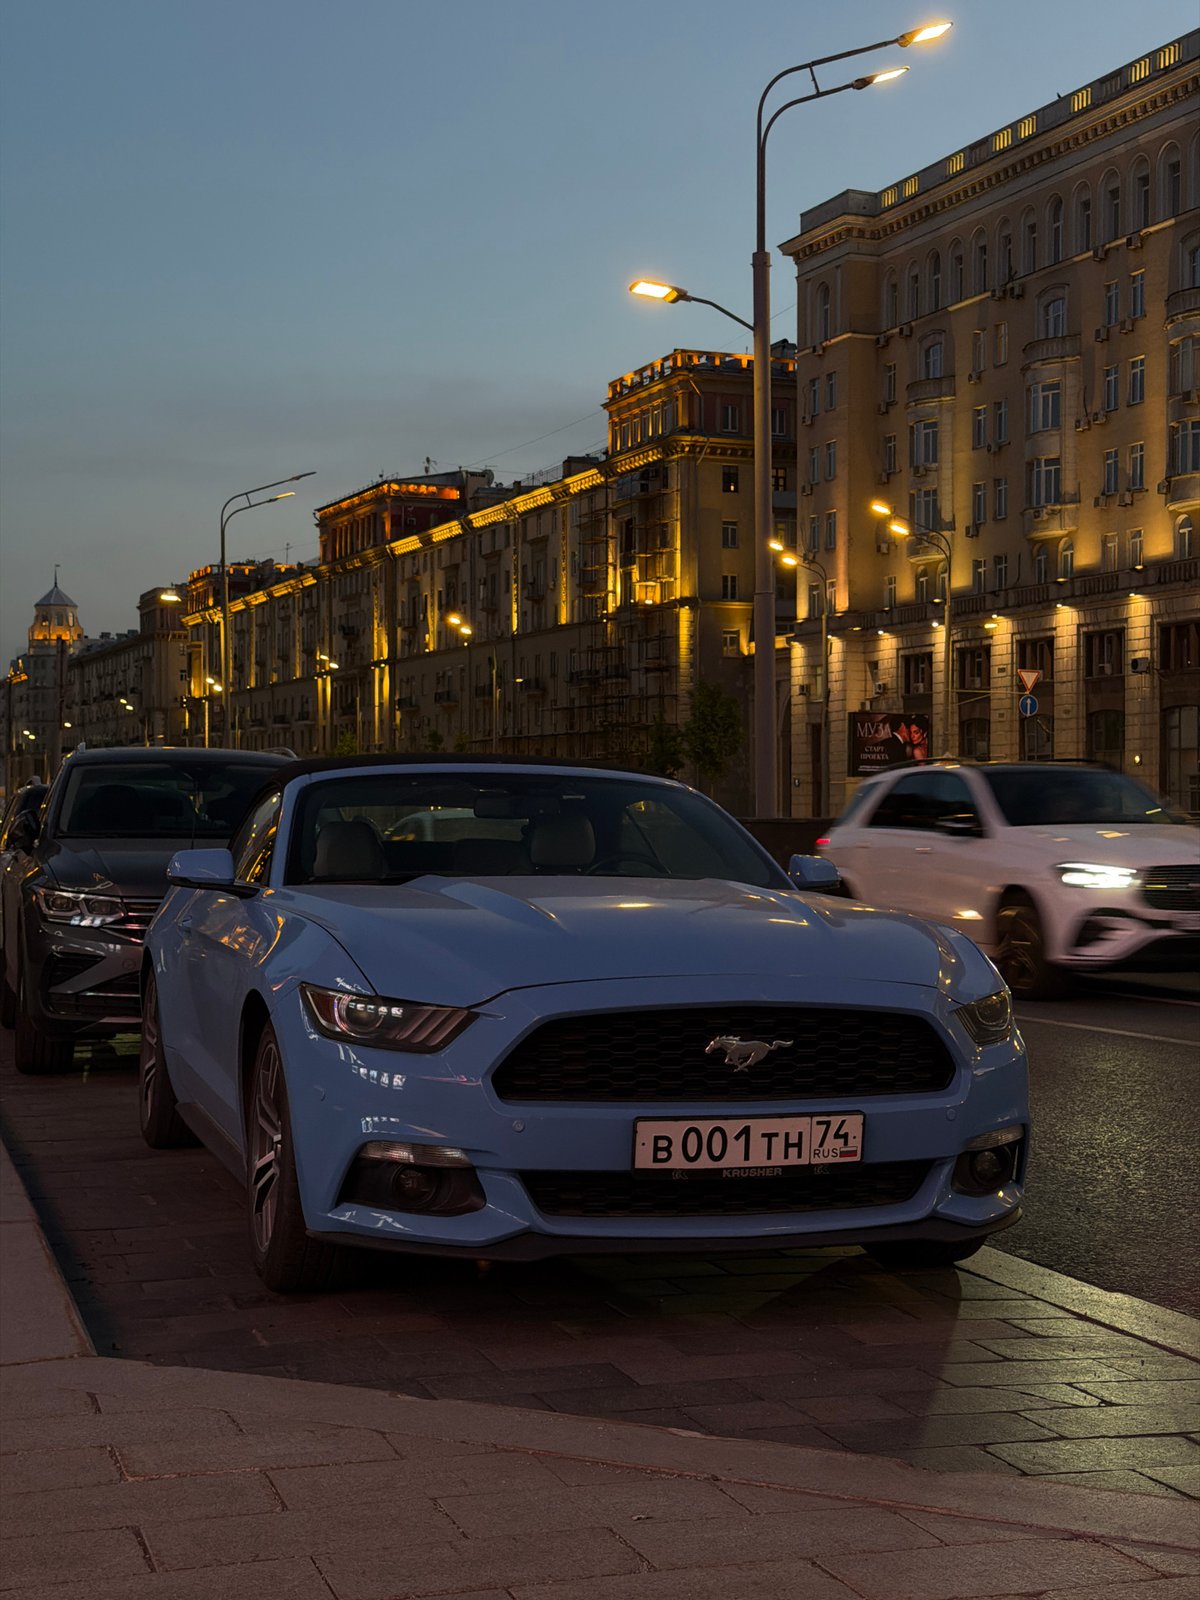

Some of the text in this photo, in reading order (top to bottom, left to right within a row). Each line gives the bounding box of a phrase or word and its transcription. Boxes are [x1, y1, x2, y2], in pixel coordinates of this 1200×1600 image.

[856, 722, 893, 738] МУЗА
[815, 1119, 849, 1149] 74
[812, 1148, 839, 1159] RUS
[722, 1168, 782, 1178] KRUSHER
